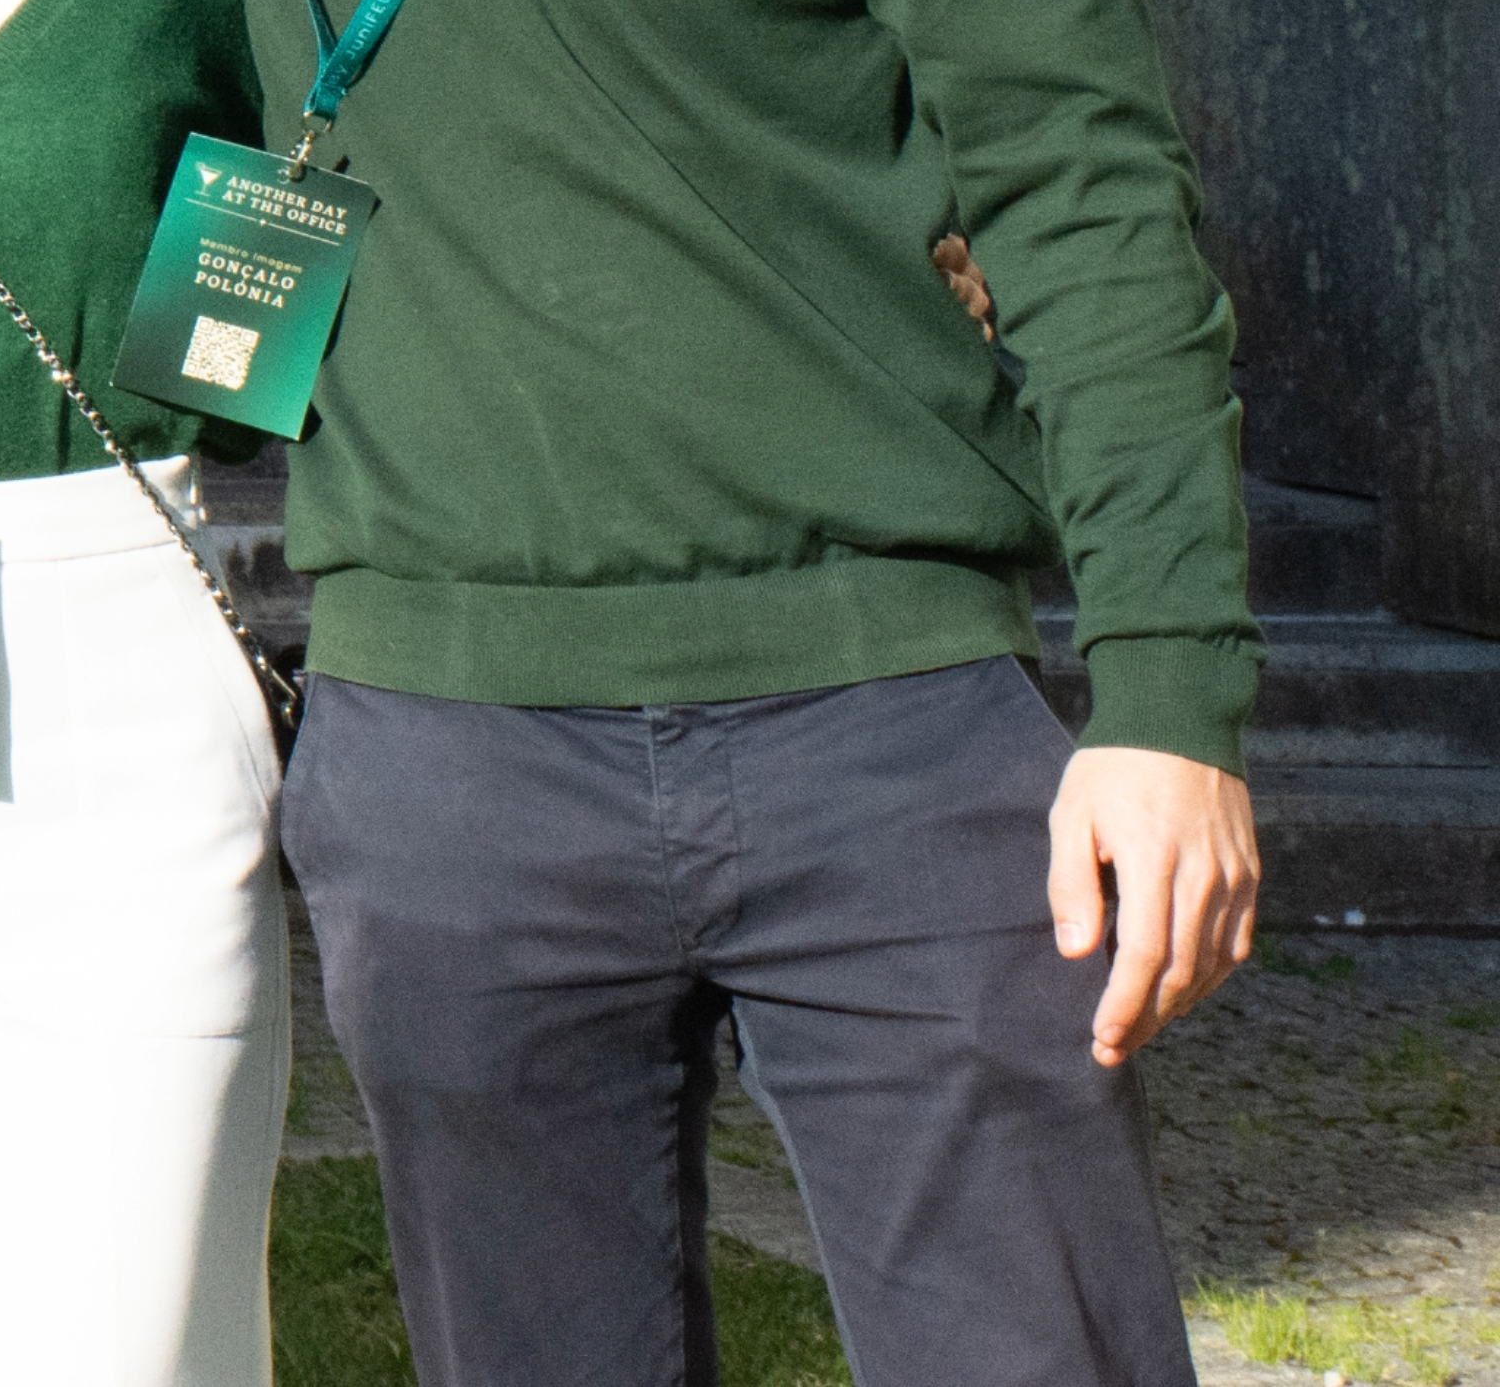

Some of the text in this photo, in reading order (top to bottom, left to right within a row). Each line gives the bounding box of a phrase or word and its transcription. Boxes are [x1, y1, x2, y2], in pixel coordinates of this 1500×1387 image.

[222, 189, 348, 236] AT THE OFFICE
[227, 176, 348, 220] ANOTHER DAY
[194, 271, 285, 309] POLÓNIA
[198, 252, 296, 291] GONÇALO
